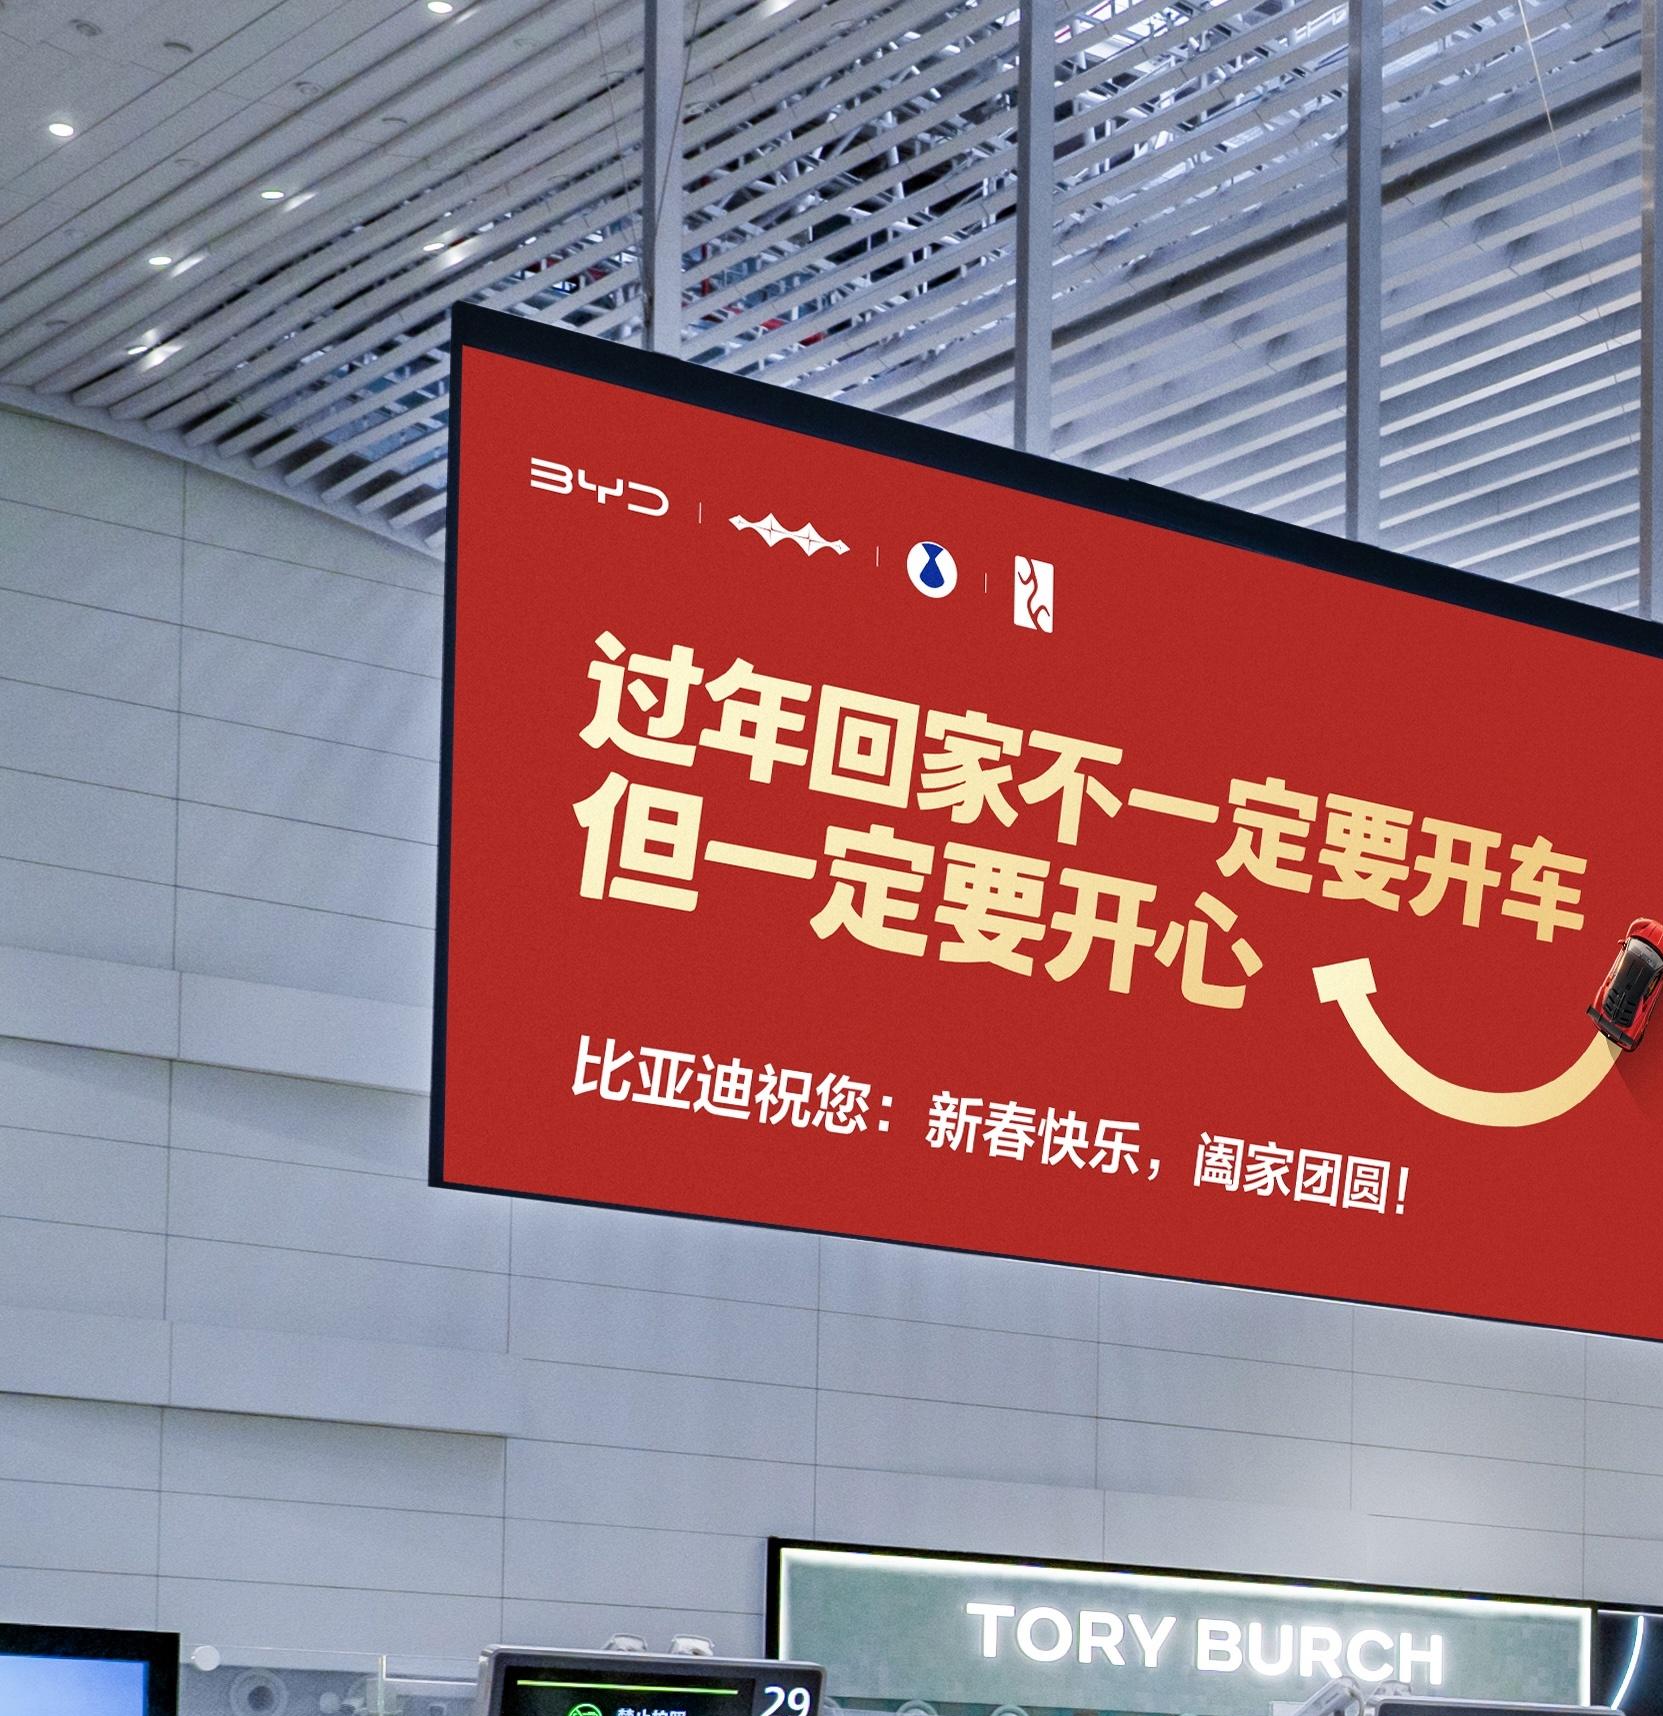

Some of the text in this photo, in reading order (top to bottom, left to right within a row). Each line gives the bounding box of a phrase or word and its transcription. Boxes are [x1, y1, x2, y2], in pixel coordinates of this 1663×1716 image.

[530, 457, 670, 517] BYD
[578, 630, 1588, 943] 过年回家不一定要开车
[573, 771, 1263, 1010] 但一定要开心
[966, 1602, 1443, 1686] TORY BURCH
